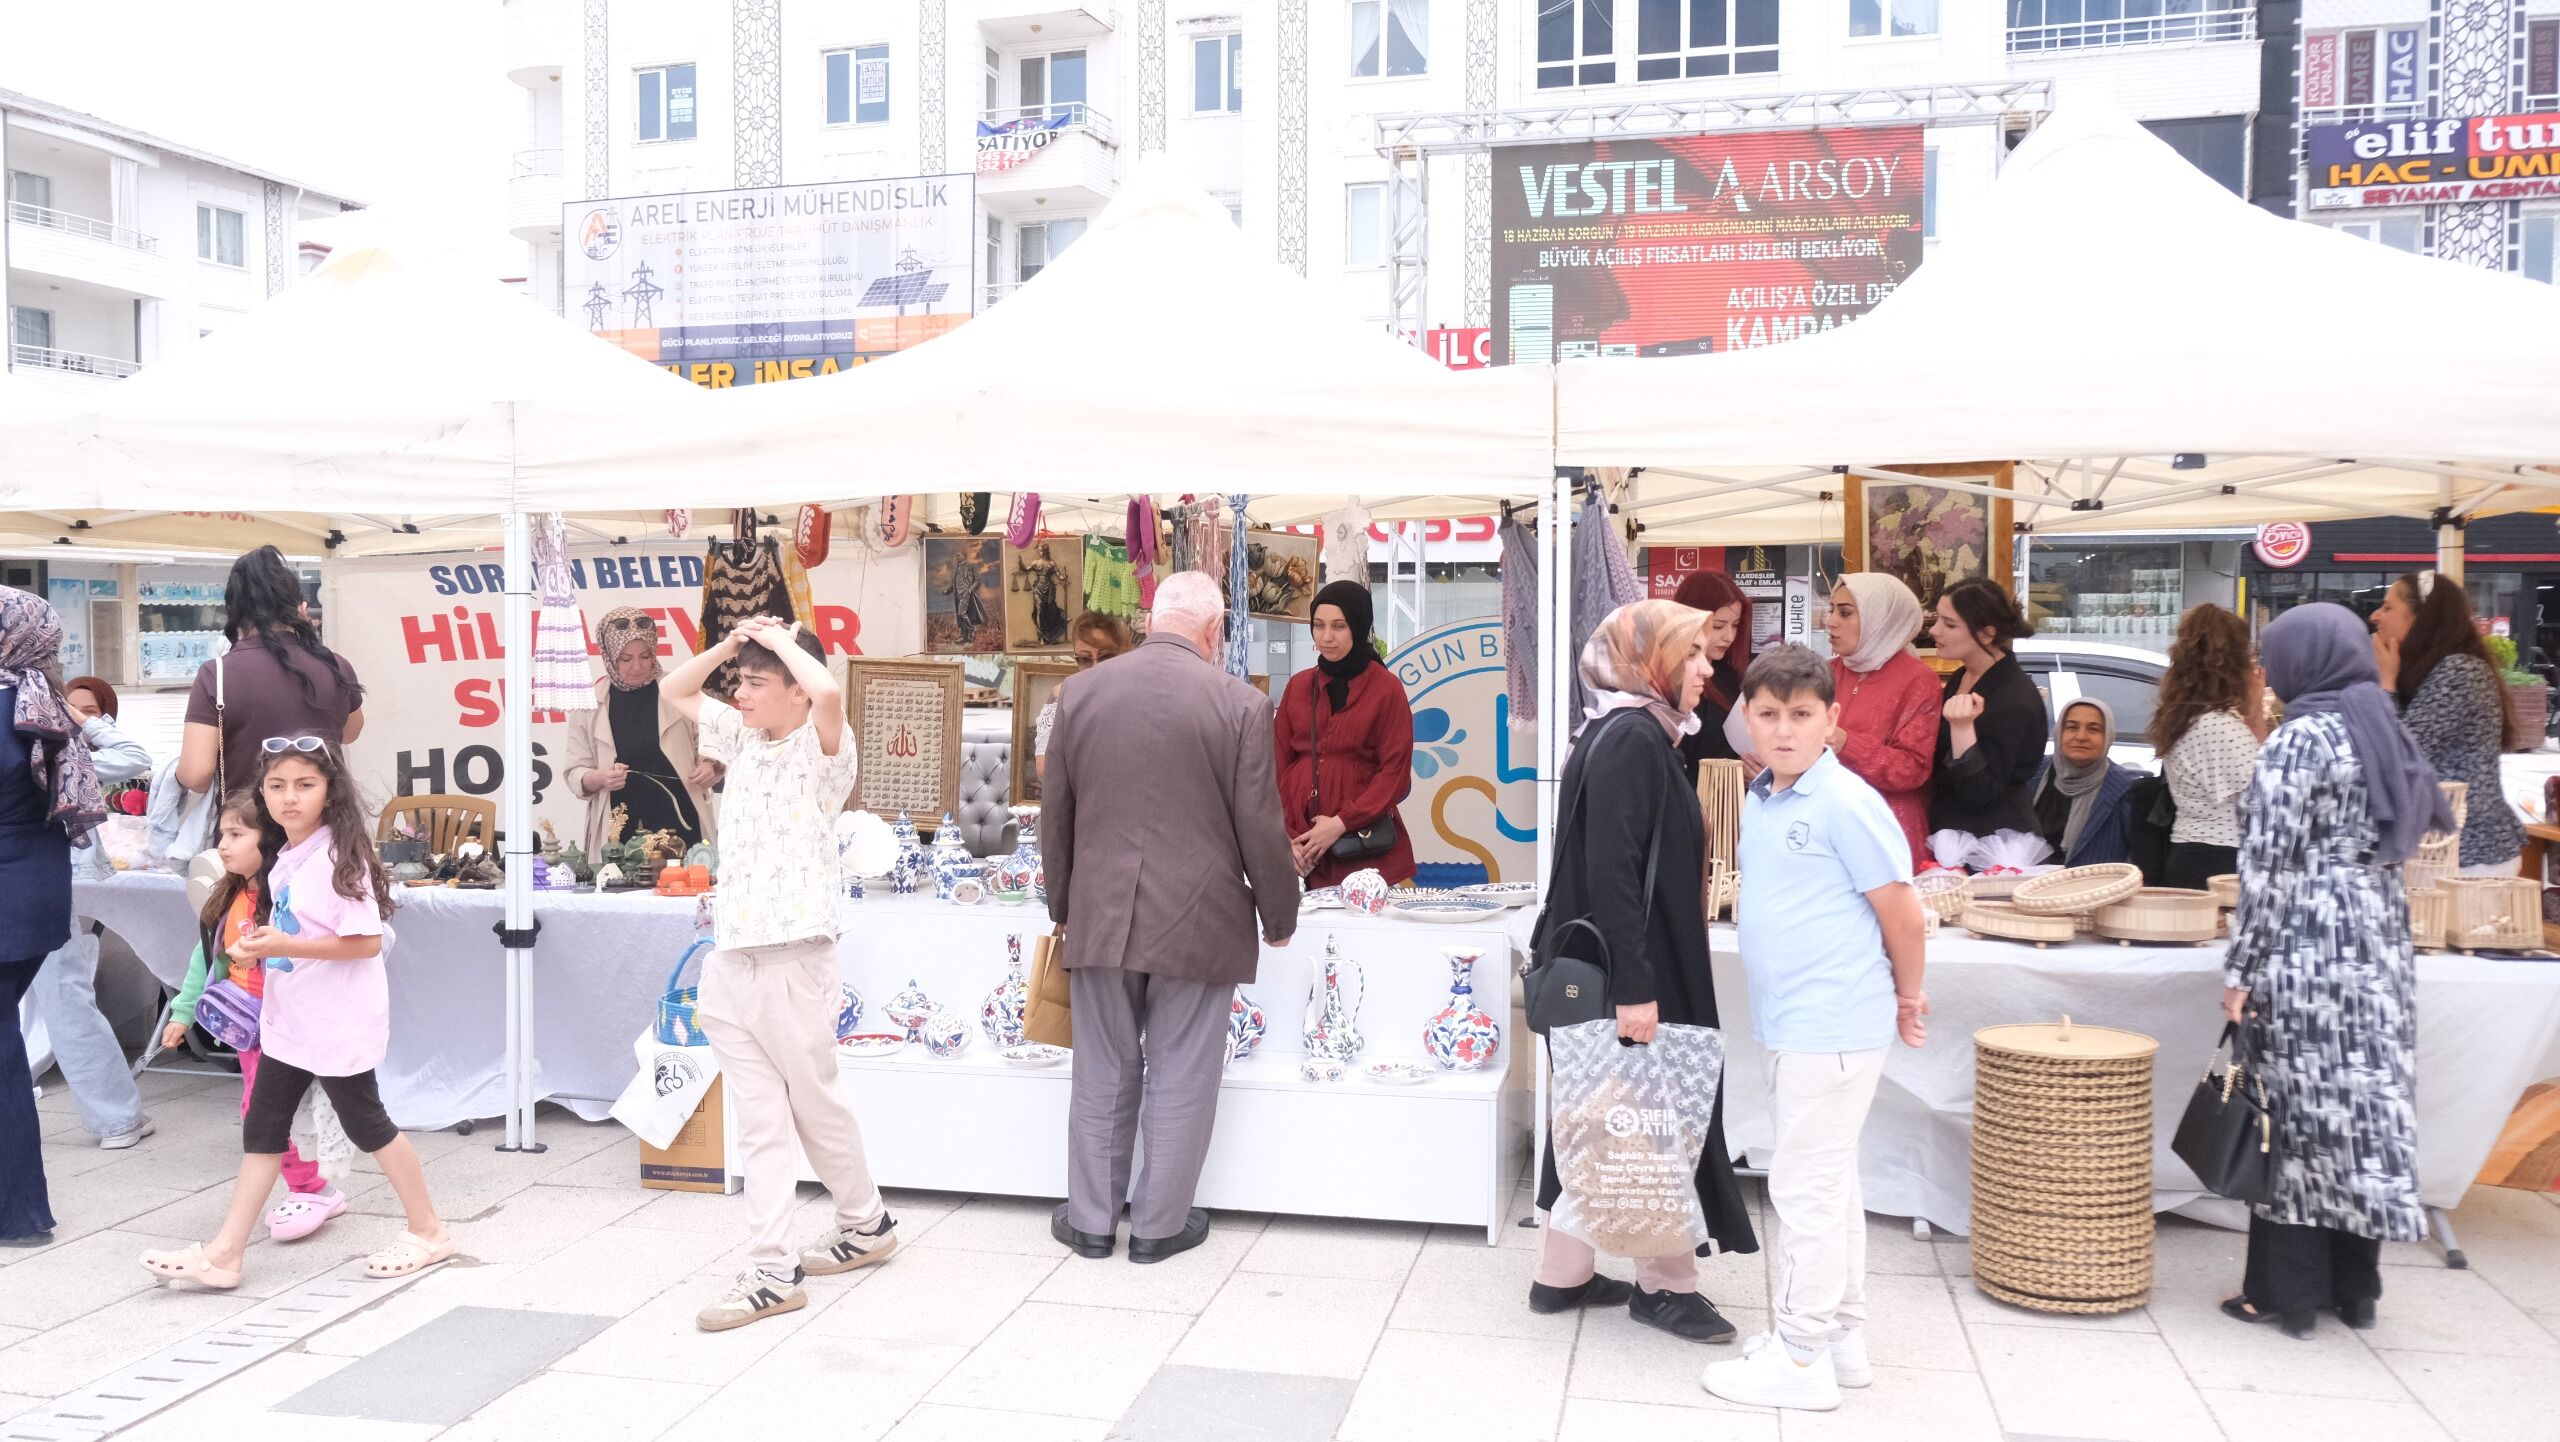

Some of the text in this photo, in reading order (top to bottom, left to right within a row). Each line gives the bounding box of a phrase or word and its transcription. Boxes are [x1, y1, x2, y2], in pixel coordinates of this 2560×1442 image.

[2390, 32, 2414, 102] HAC
[2353, 119, 2462, 159] elif
[2329, 160, 2431, 187] HAC
[1519, 159, 1689, 218] VESTEL
[1758, 156, 1900, 202] ARSOY
[2363, 184, 2464, 205] SEYAHAT
[630, 181, 948, 228] AREL ENERJİ MÜHENDİSLİK
[642, 231, 697, 245] ELEKTRİK
[736, 226, 774, 240] PROJE
[842, 215, 934, 235] DANIŞMANLIK
[1517, 225, 1566, 242] HAZİRAN
[1567, 225, 1614, 241] SORGUN
[1638, 221, 1688, 239] HAZİRAN
[1538, 246, 1591, 268] BÜYÜK
[1594, 247, 1642, 269] AÇILIŞ
[1646, 243, 1735, 264] FIRSATLARI
[1738, 237, 1797, 261] SİZLERİ
[1726, 285, 1808, 312] AÇILIŞ'A
[1811, 280, 1862, 306] ÖZEL
[662, 335, 684, 348] GÜCÜ
[744, 333, 782, 344] GELECEĞİ
[783, 331, 854, 343] AYDINLATIYORUZ
[1639, 1108, 1678, 1122] SIFIR
[1641, 1122, 1680, 1136] ATIK
[1594, 1162, 1624, 1173] Temiz
[1626, 1162, 1655, 1175] Çevre
[1600, 1174, 1632, 1184] Sende
[1601, 1186, 1656, 1196] Hareketine
